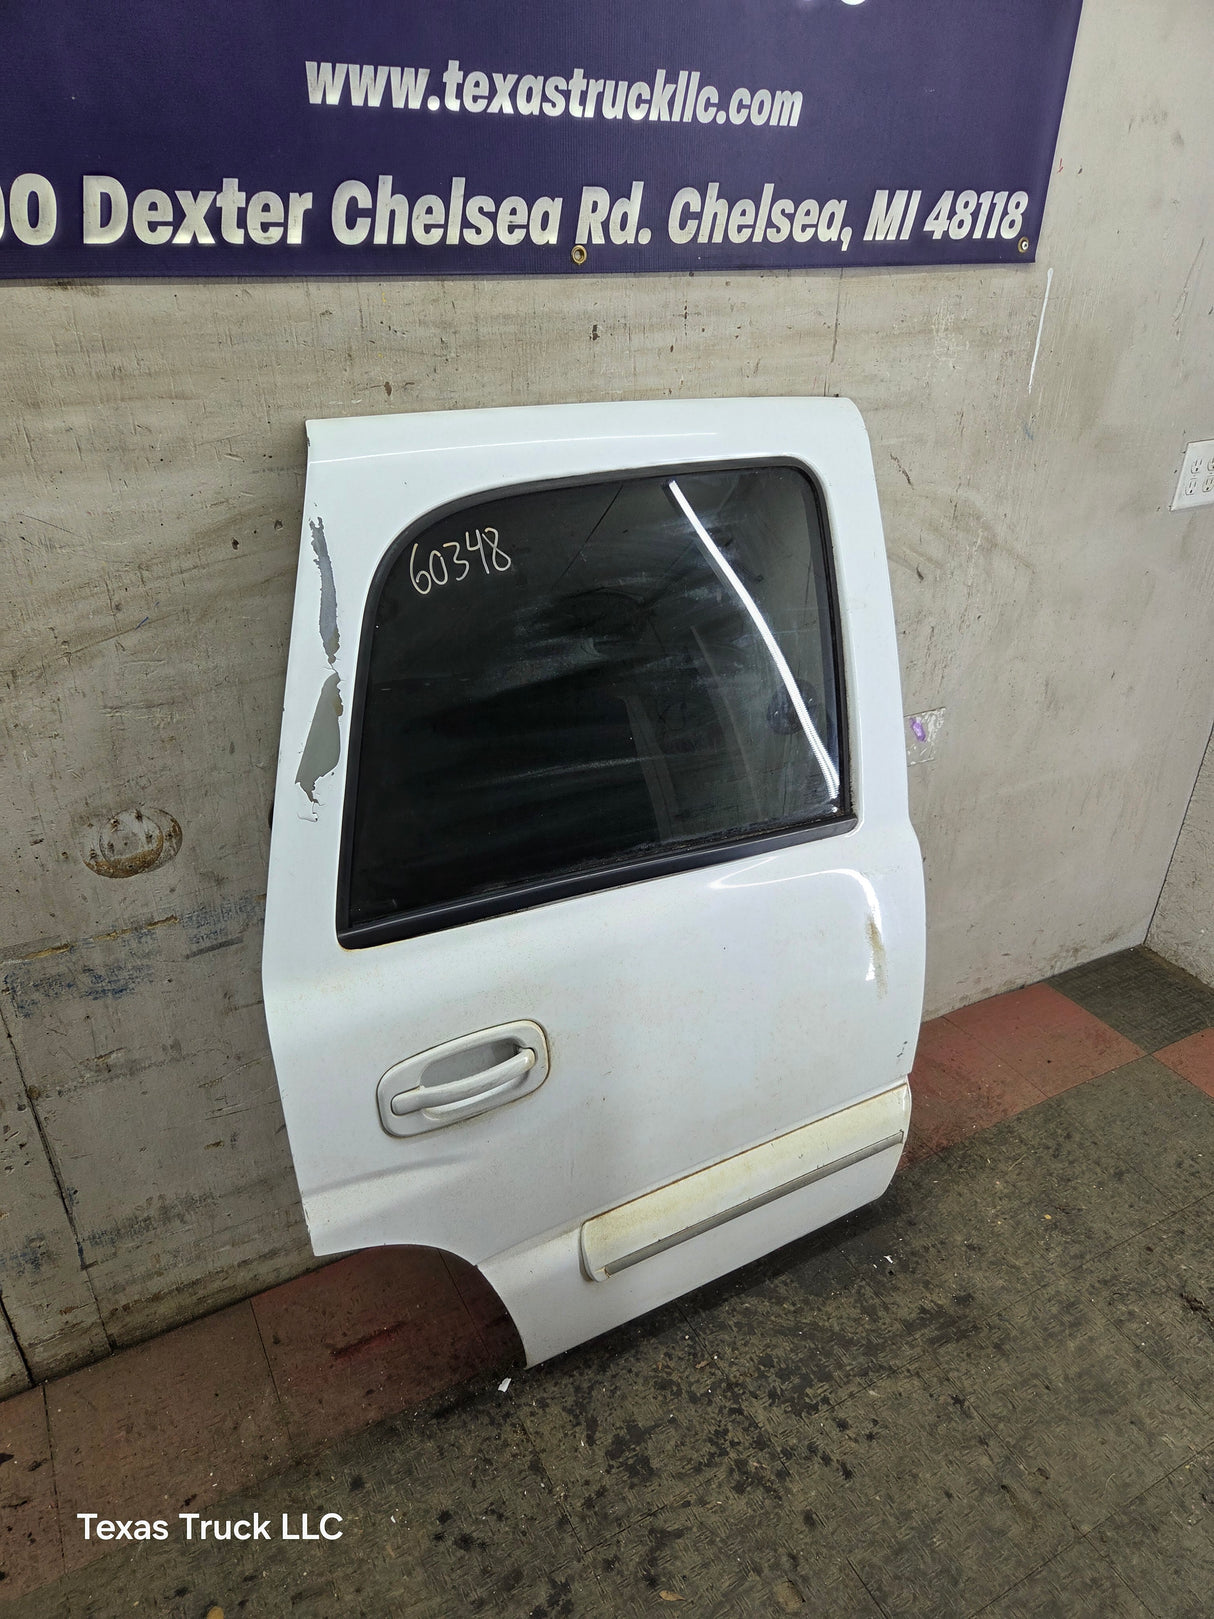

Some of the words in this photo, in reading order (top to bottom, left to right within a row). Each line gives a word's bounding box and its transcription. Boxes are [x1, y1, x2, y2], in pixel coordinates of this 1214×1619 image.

[306, 60, 803, 127] www.texastruckllc.com
[0, 173, 57, 245] 0
[83, 175, 312, 244] Dexter
[332, 175, 563, 245] Chelsea
[575, 181, 651, 244] Rd.
[668, 183, 852, 251] Chelsea,
[863, 190, 922, 241] MI
[924, 190, 1028, 240] 48118
[410, 527, 511, 594] 60348
